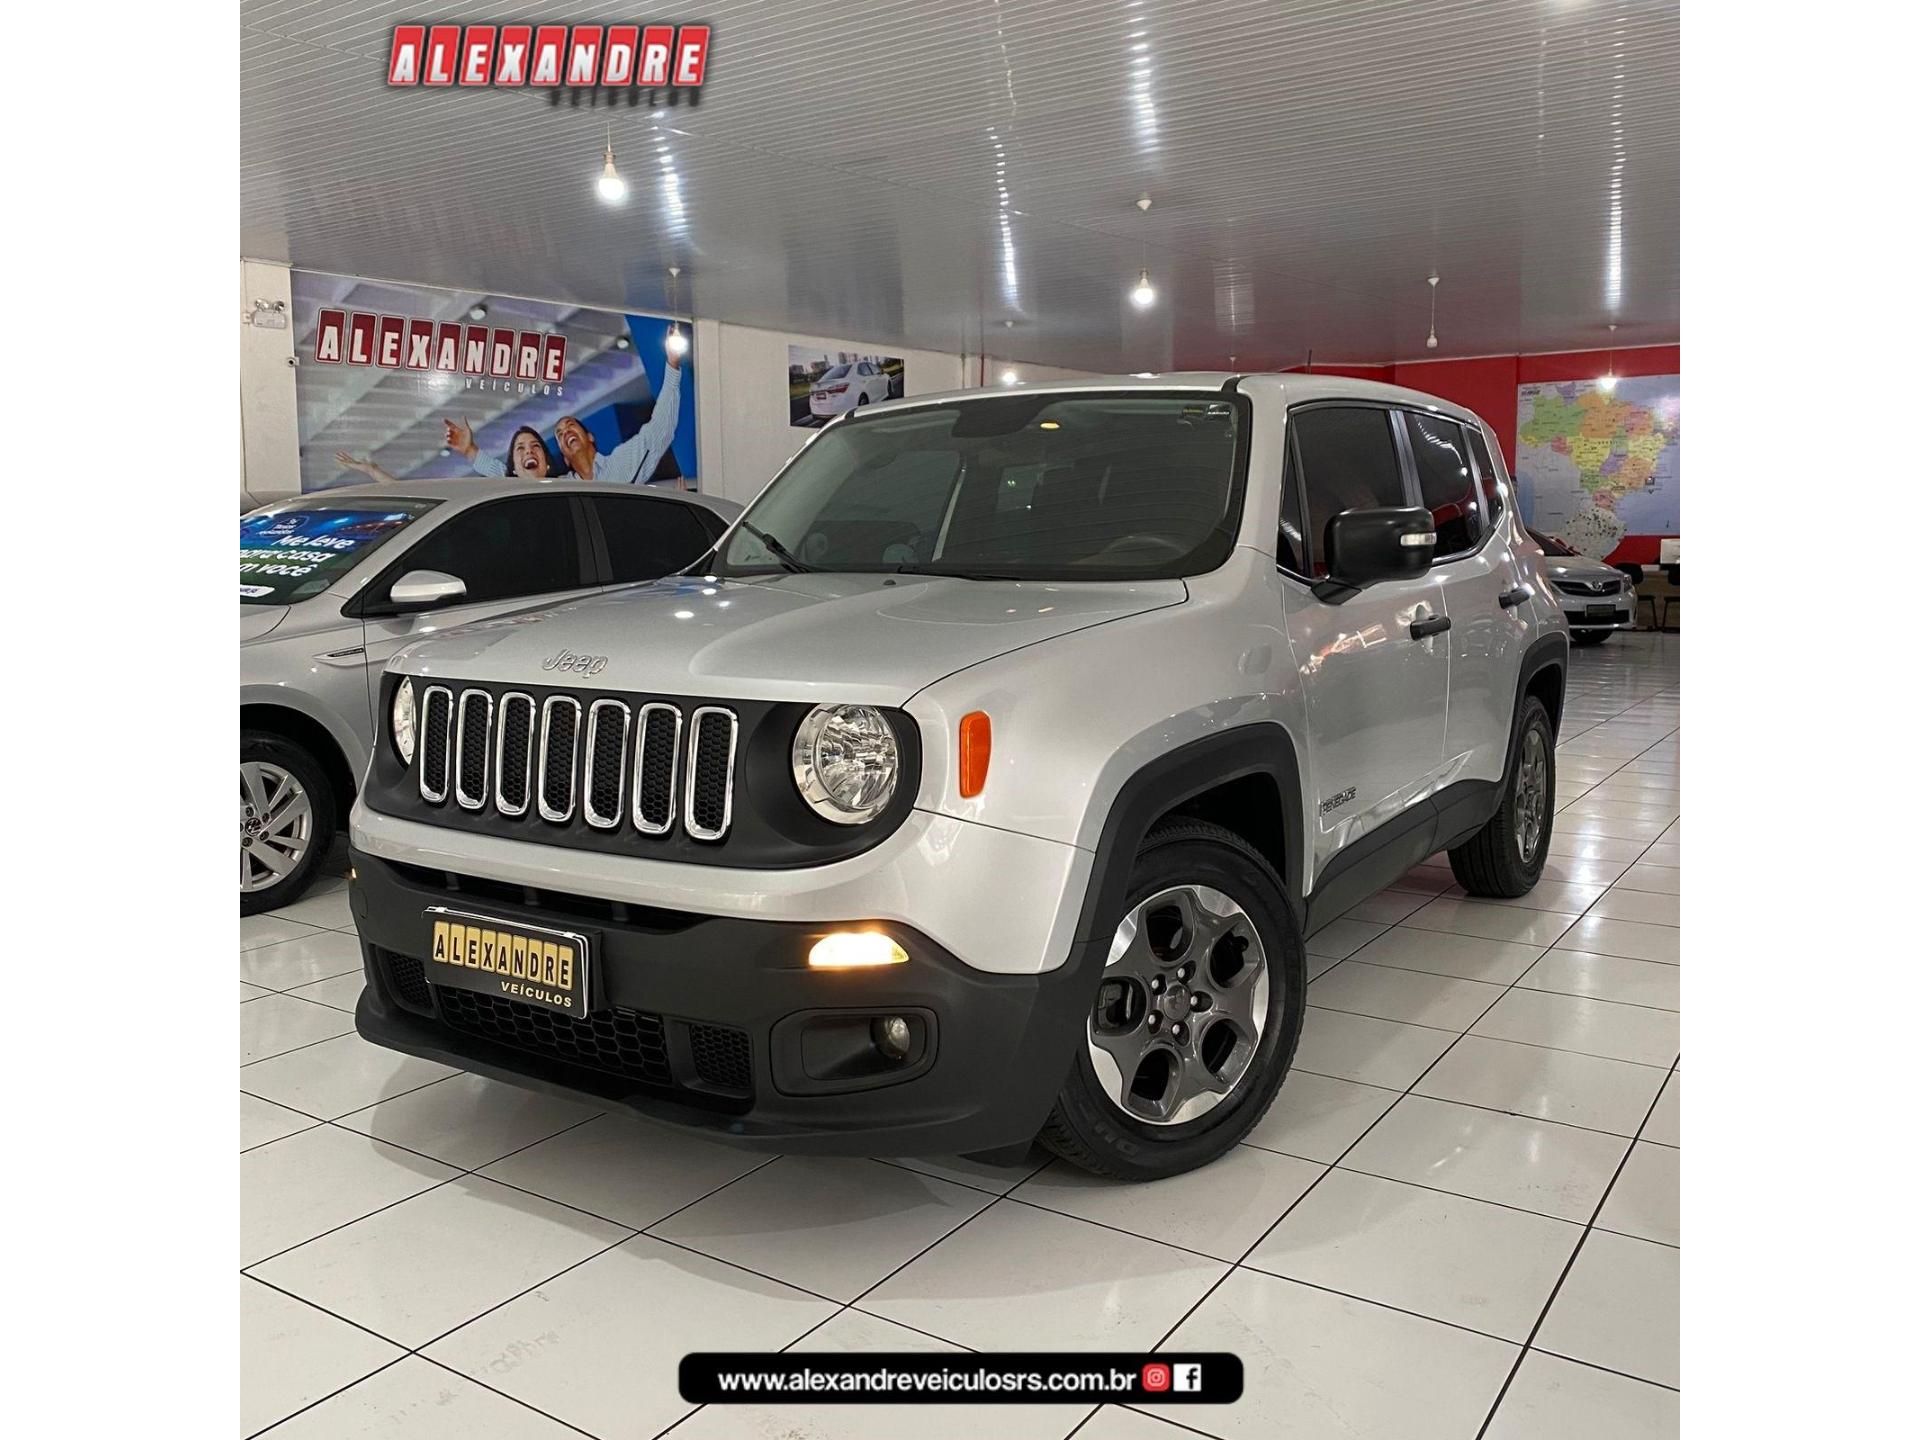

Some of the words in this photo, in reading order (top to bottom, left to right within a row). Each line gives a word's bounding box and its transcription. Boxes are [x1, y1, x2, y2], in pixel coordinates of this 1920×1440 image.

[318, 324, 562, 380] ALEXANDRE
[240, 549, 279, 559] ara
[270, 534, 310, 547] Me
[303, 534, 356, 549] leve
[256, 563, 319, 577] você
[542, 648, 608, 680] Jeep
[434, 933, 570, 987] ALEXANDRE
[500, 979, 573, 1009] VEÍCULOS
